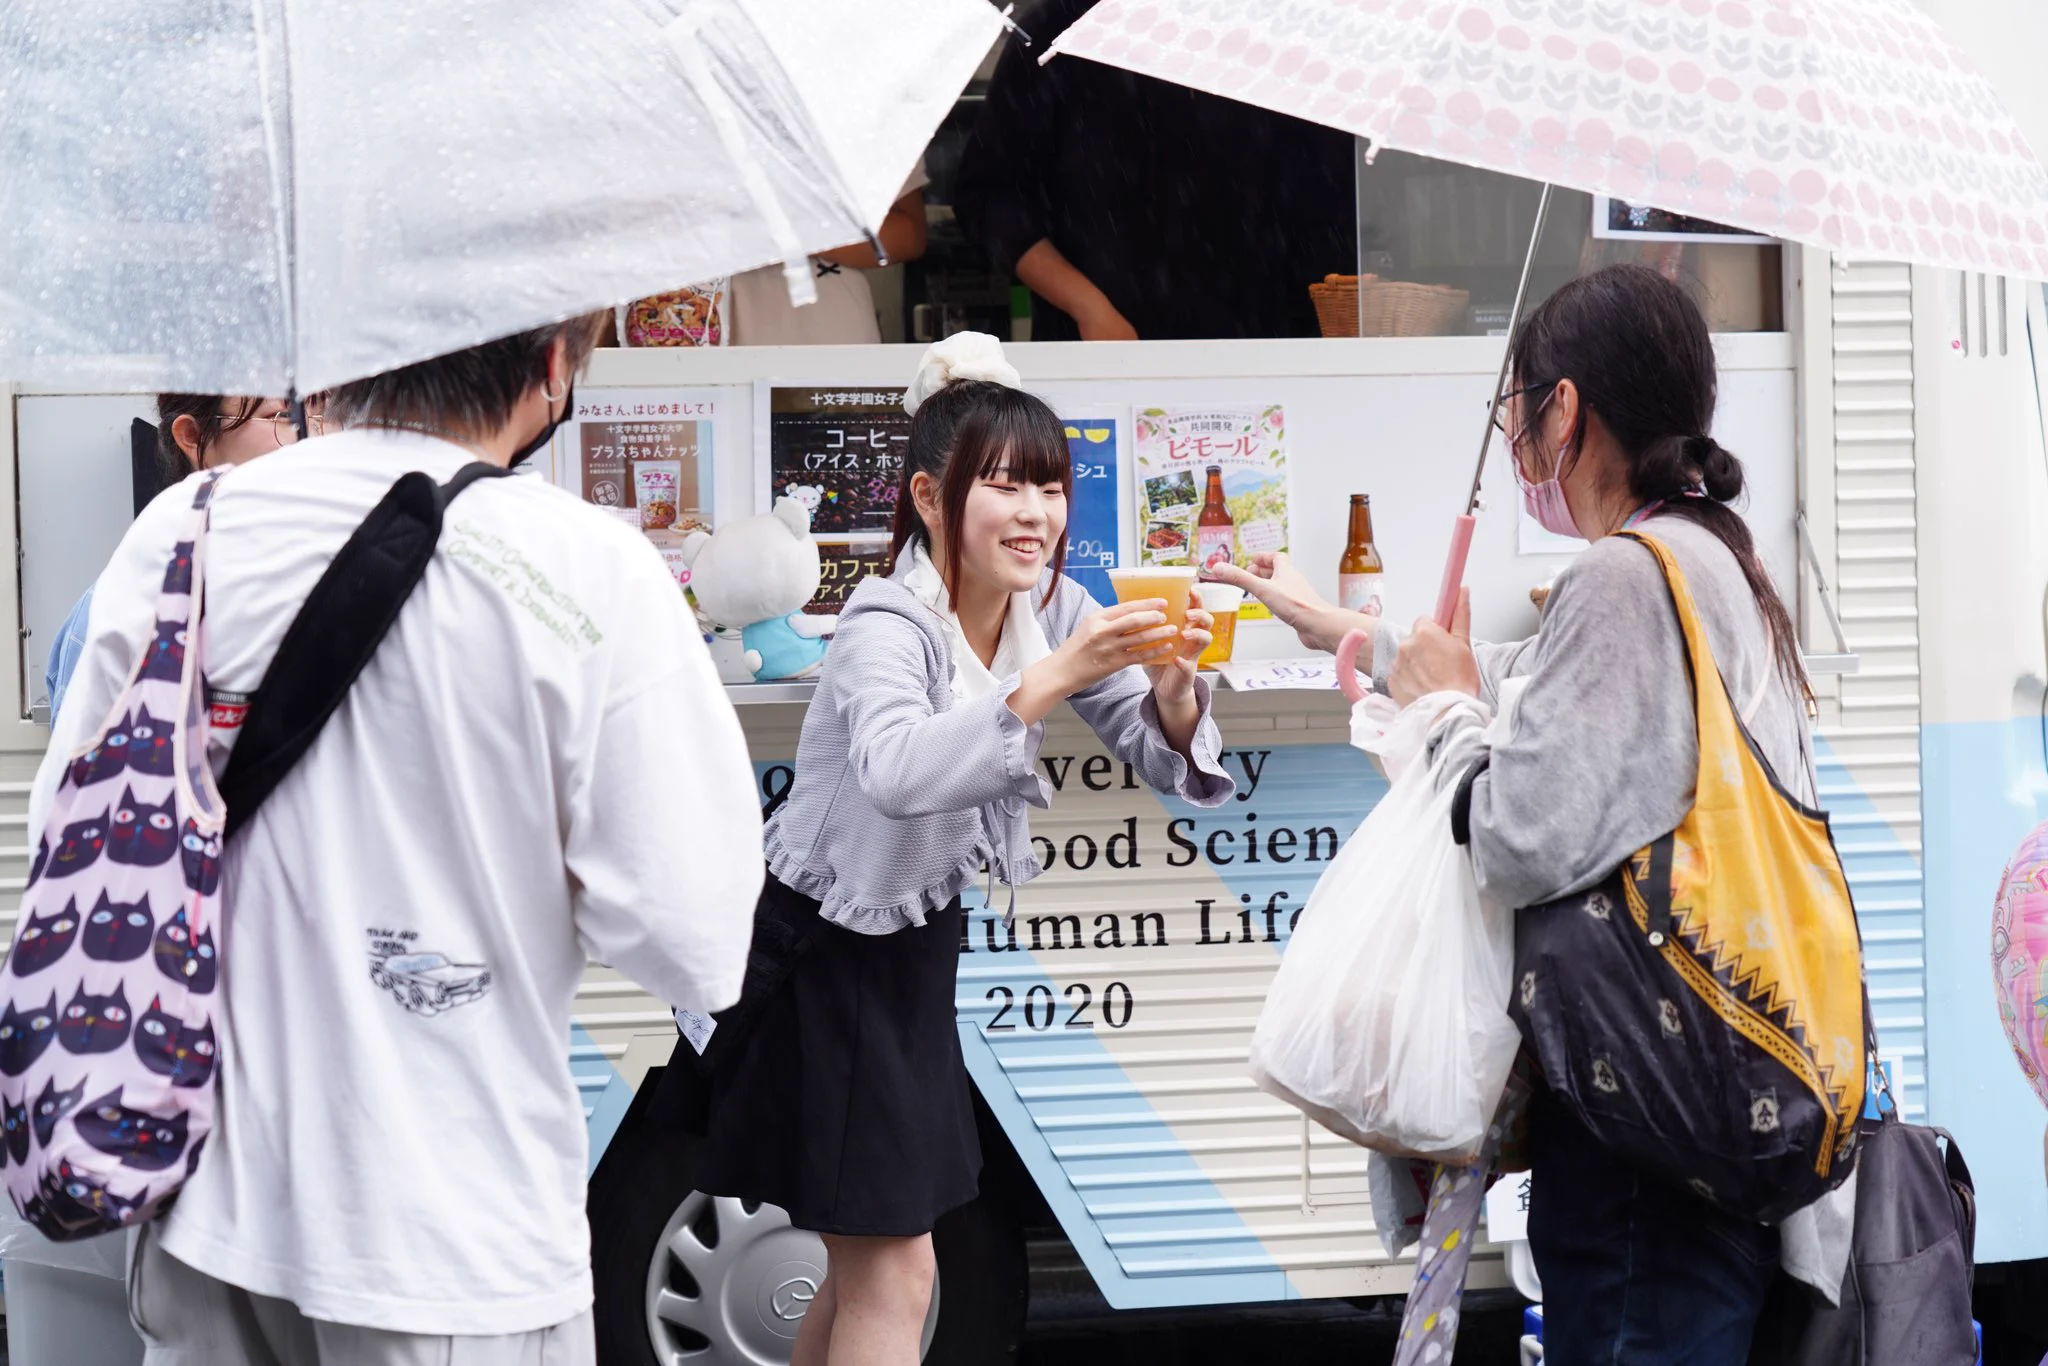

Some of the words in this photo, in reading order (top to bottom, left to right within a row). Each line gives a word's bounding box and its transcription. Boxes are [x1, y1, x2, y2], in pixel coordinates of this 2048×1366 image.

[826, 428, 910, 448] コーヒー
[1168, 435, 1260, 460] ピモール
[590, 444, 700, 459] プラスちゃんナッツ
[662, 552, 682, 562] 価格
[819, 558, 891, 579] カフェ
[980, 816, 1142, 874] ood
[1166, 812, 1358, 868] Scien
[985, 980, 1134, 1034] 2020
